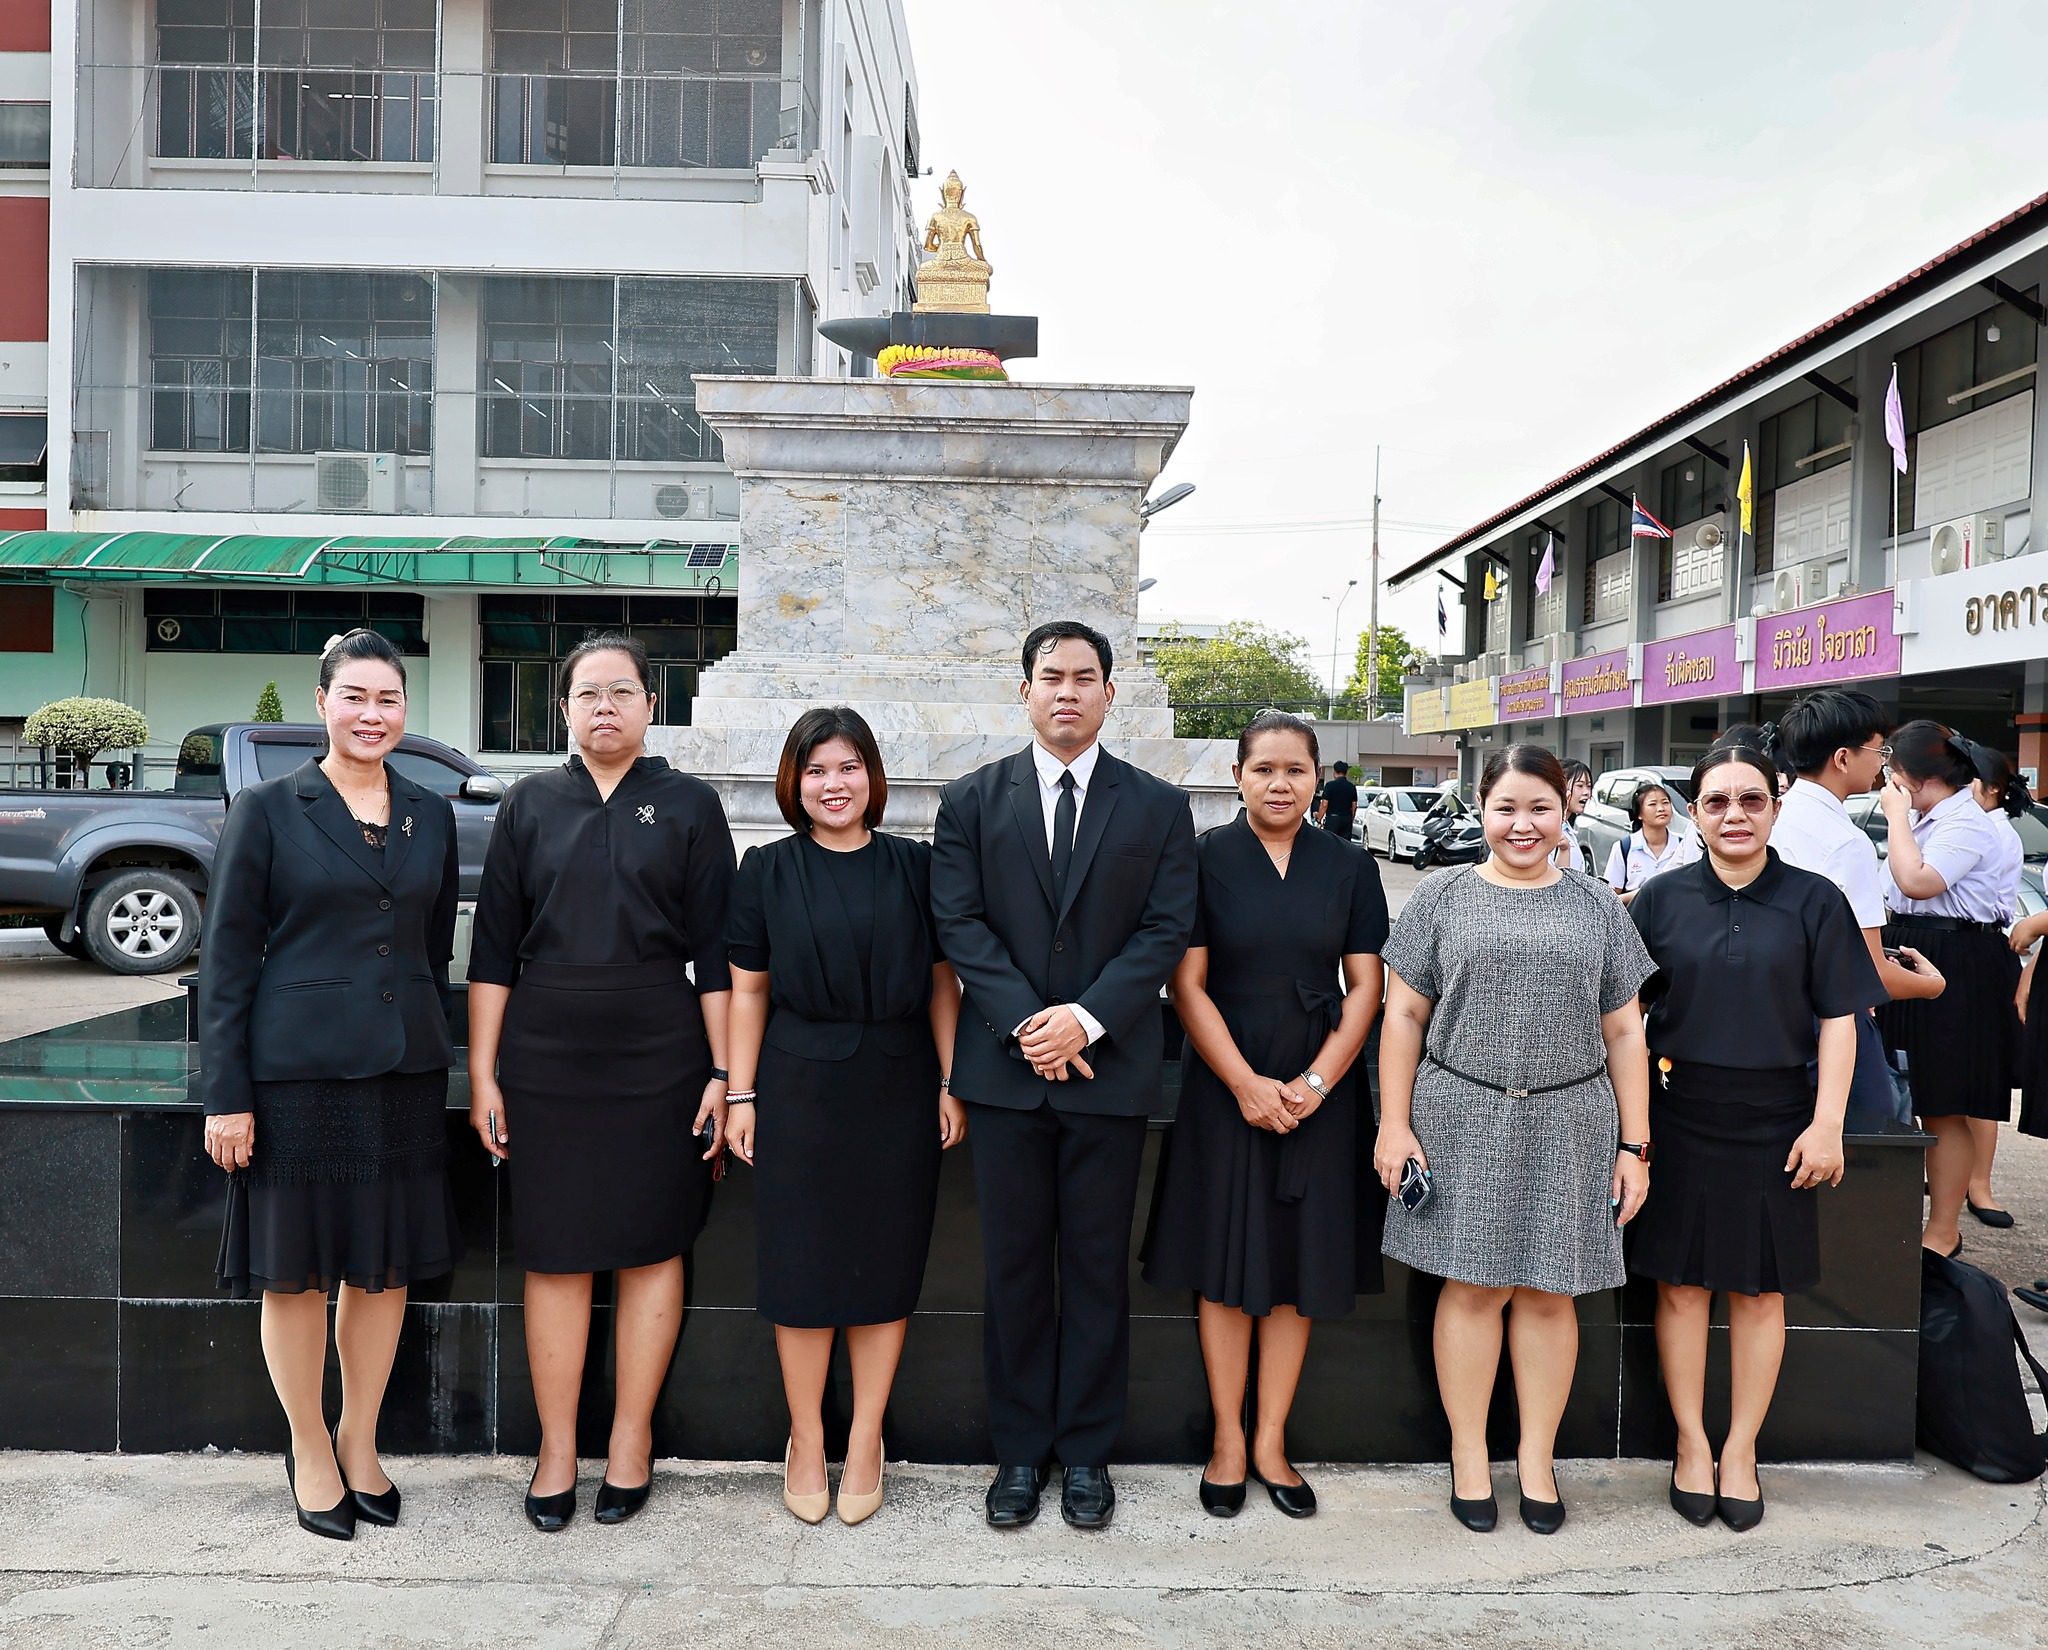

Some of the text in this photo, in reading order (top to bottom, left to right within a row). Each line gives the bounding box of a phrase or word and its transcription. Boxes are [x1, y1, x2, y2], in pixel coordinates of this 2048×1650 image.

[1773, 614, 1876, 670] มีวินัย ใจอาสา
[1665, 651, 1715, 687] รับผิดชอบ
